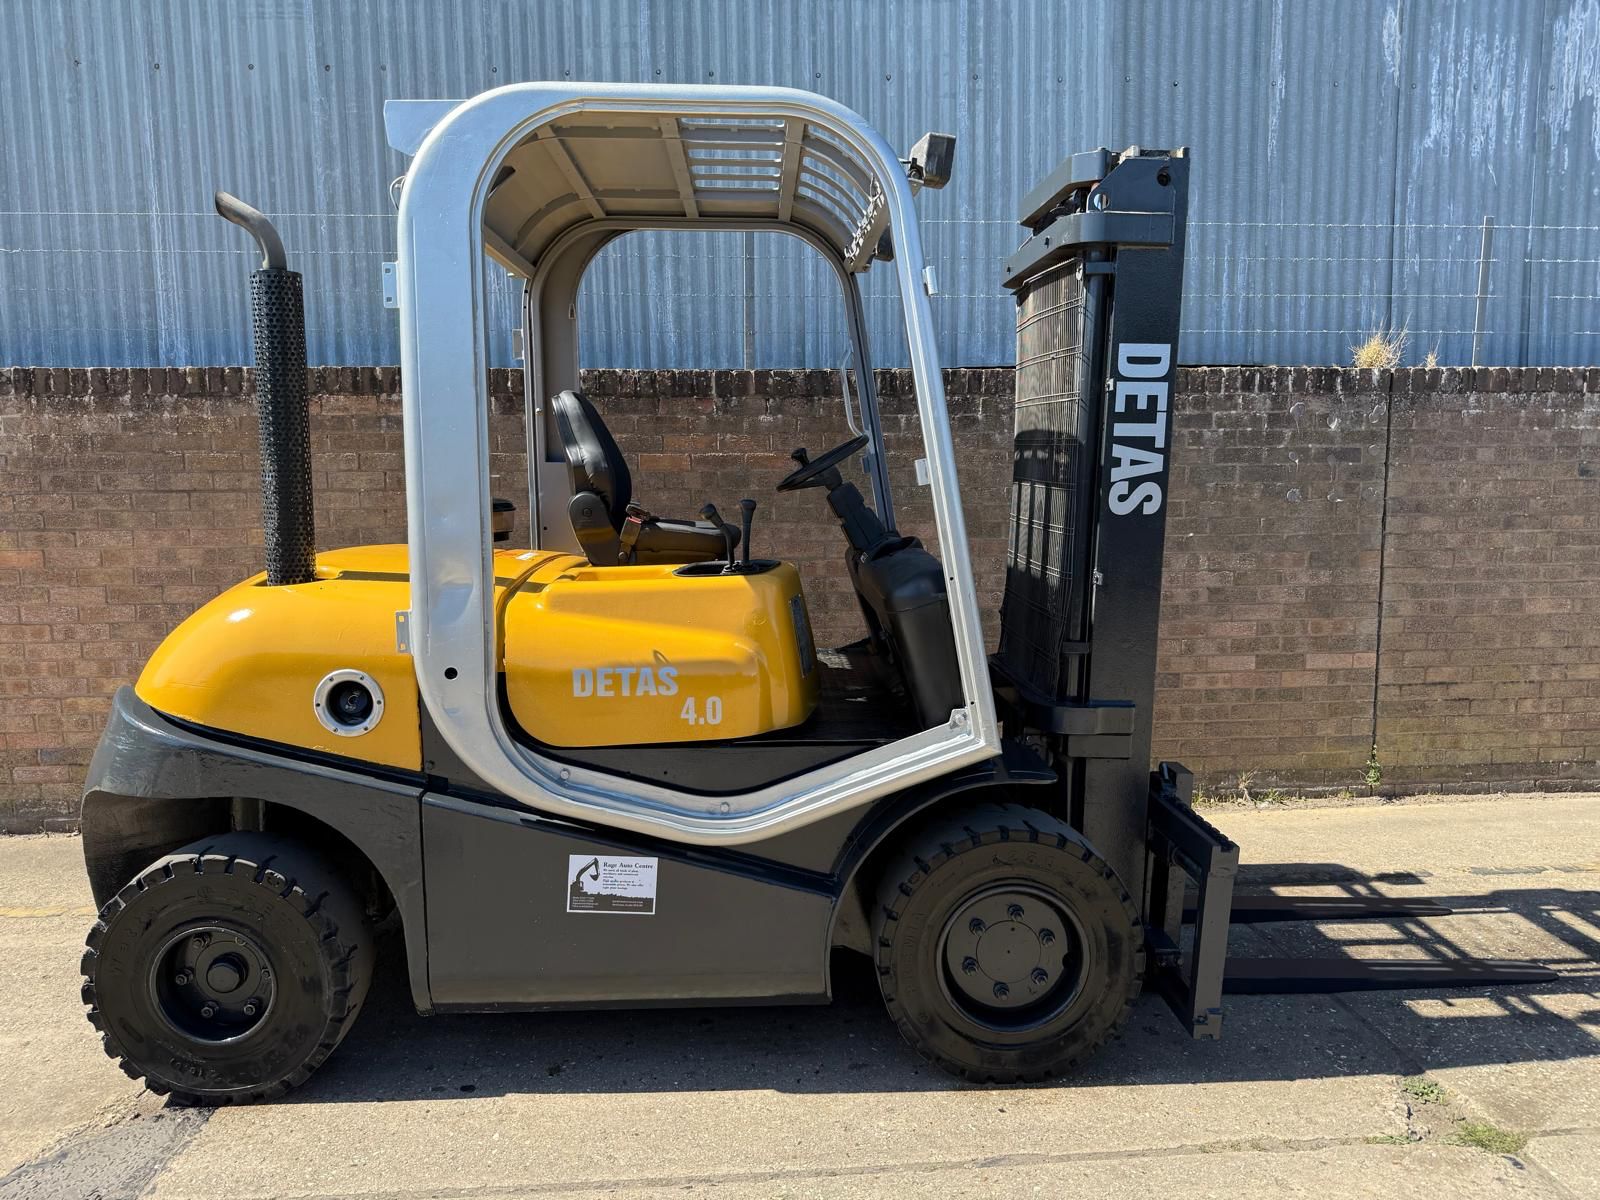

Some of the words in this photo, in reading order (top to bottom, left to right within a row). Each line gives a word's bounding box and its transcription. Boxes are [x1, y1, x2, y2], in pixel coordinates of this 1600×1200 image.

[1108, 343, 1171, 516] DETAS
[572, 666, 679, 697] DETAS
[680, 696, 722, 725] 4.0
